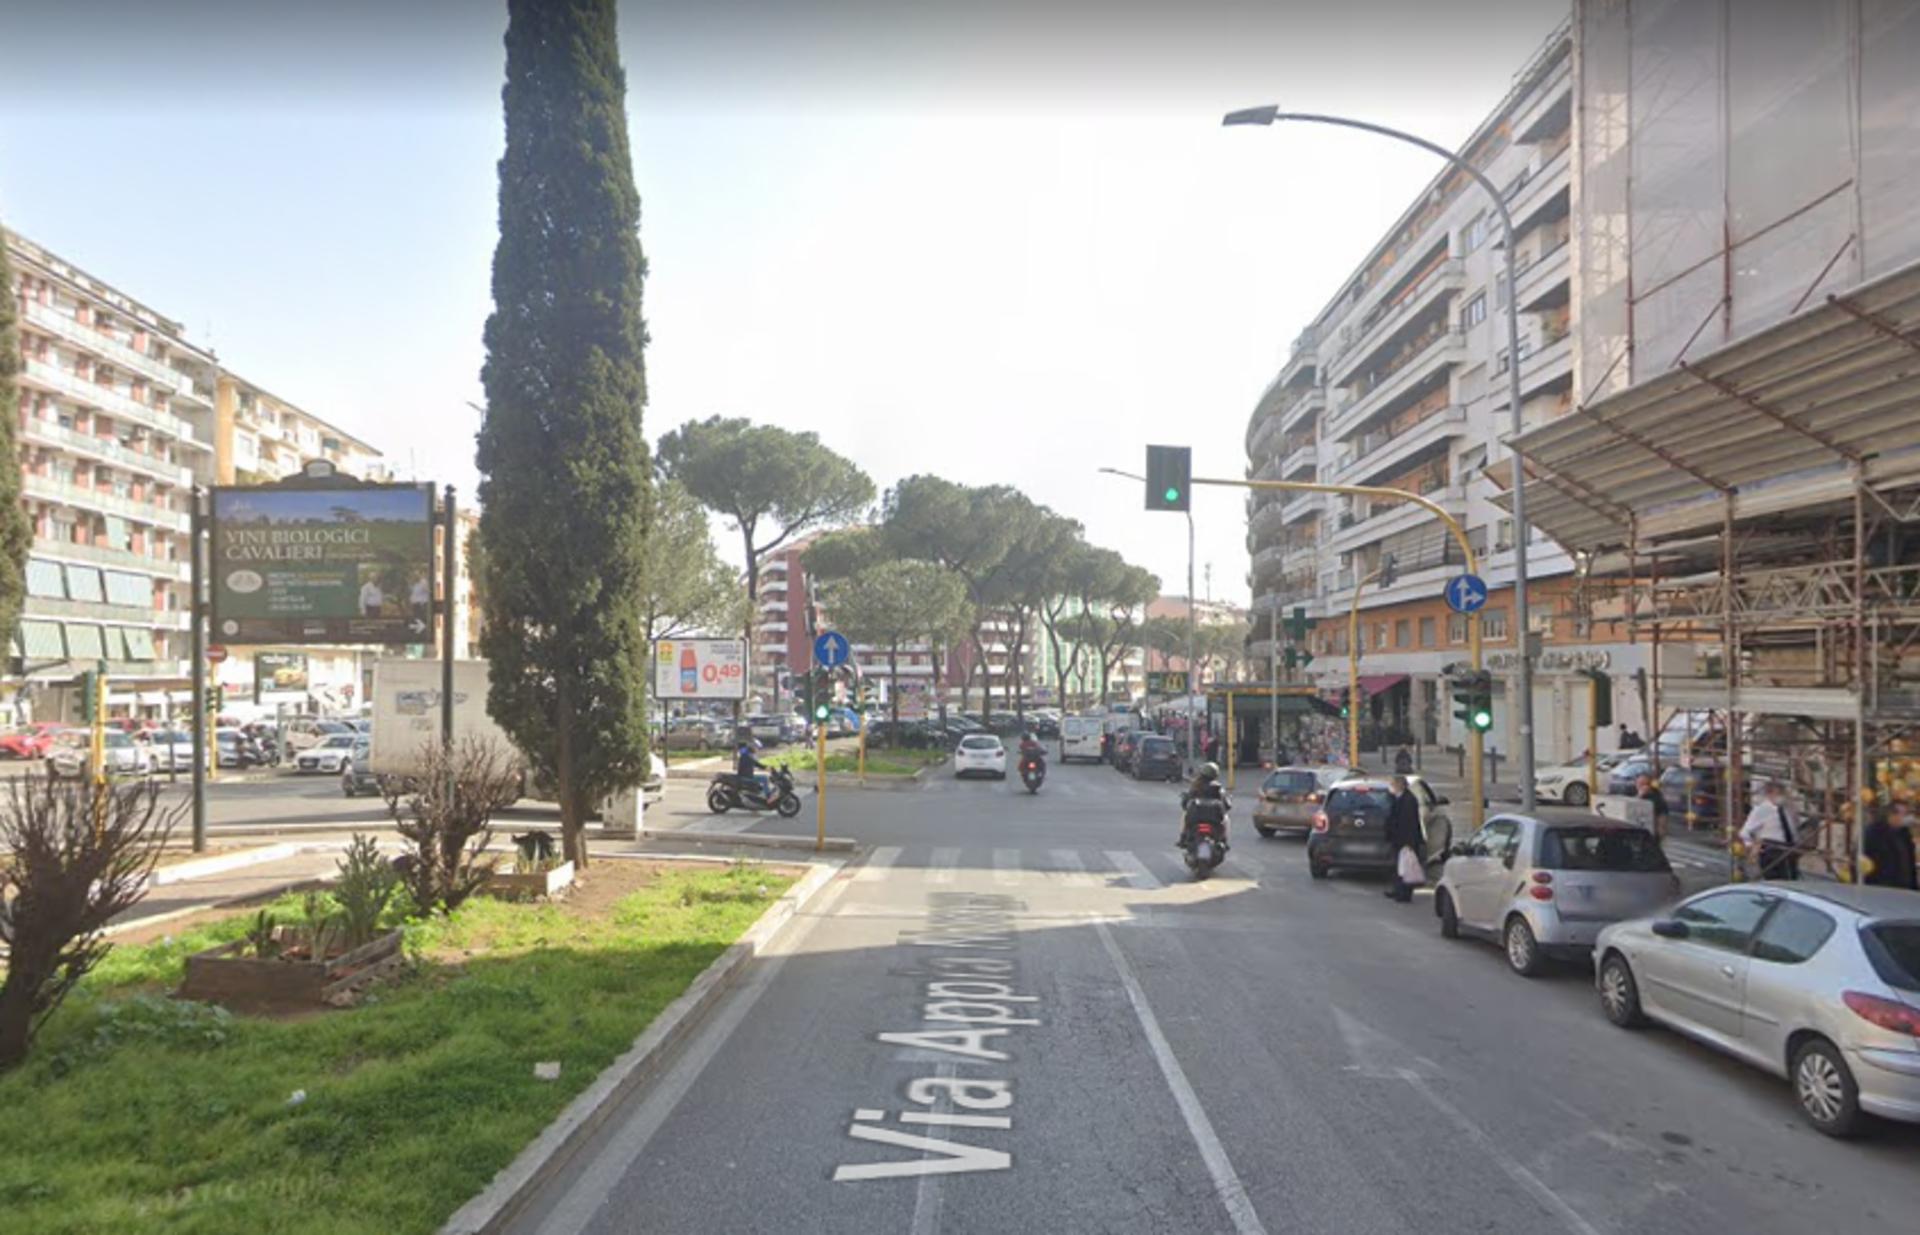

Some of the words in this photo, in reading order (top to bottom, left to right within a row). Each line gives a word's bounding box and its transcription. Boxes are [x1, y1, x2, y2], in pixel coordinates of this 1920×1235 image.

[225, 529, 267, 545] VINI
[271, 528, 370, 545] BIOLOGICI
[225, 544, 323, 561] CAVALIERI
[702, 663, 742, 685] 0,49
